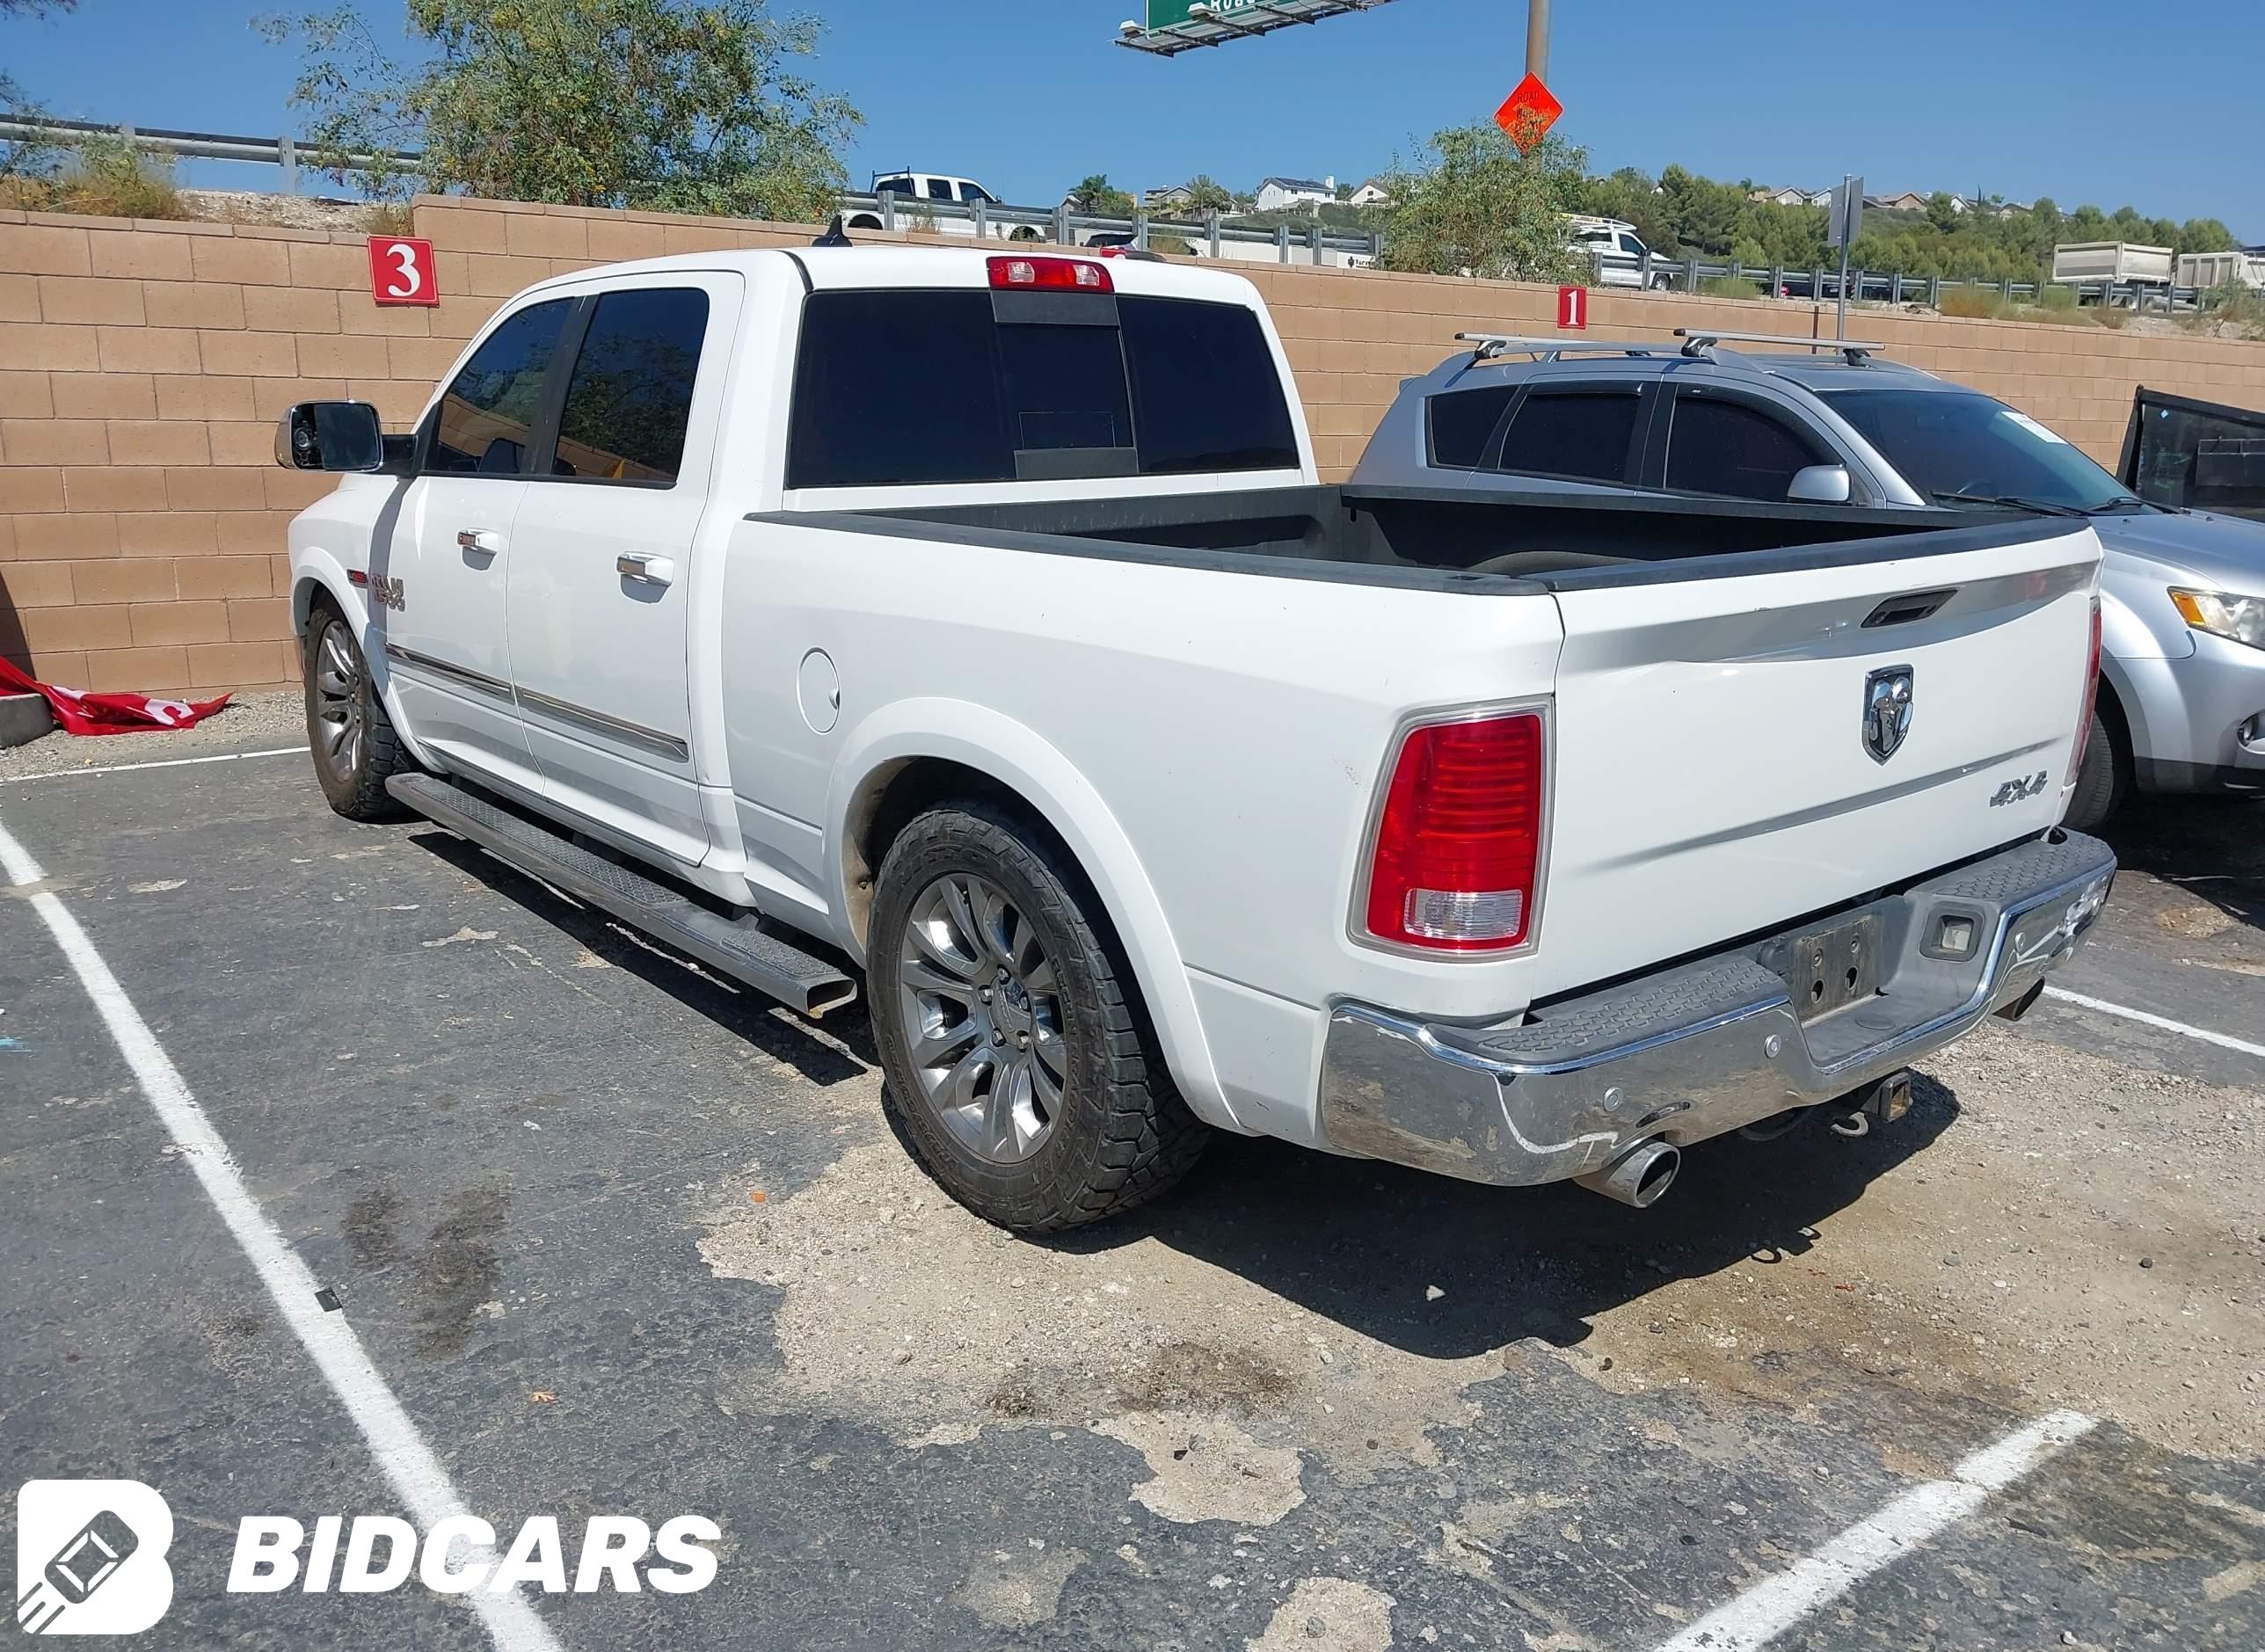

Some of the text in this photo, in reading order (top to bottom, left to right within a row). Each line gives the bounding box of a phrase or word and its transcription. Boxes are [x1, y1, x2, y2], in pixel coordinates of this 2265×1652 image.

[1517, 91, 1540, 103] ROAD
[386, 244, 421, 297] 3
[1566, 289, 1579, 325] 1
[1989, 770, 2048, 808] 4X4
